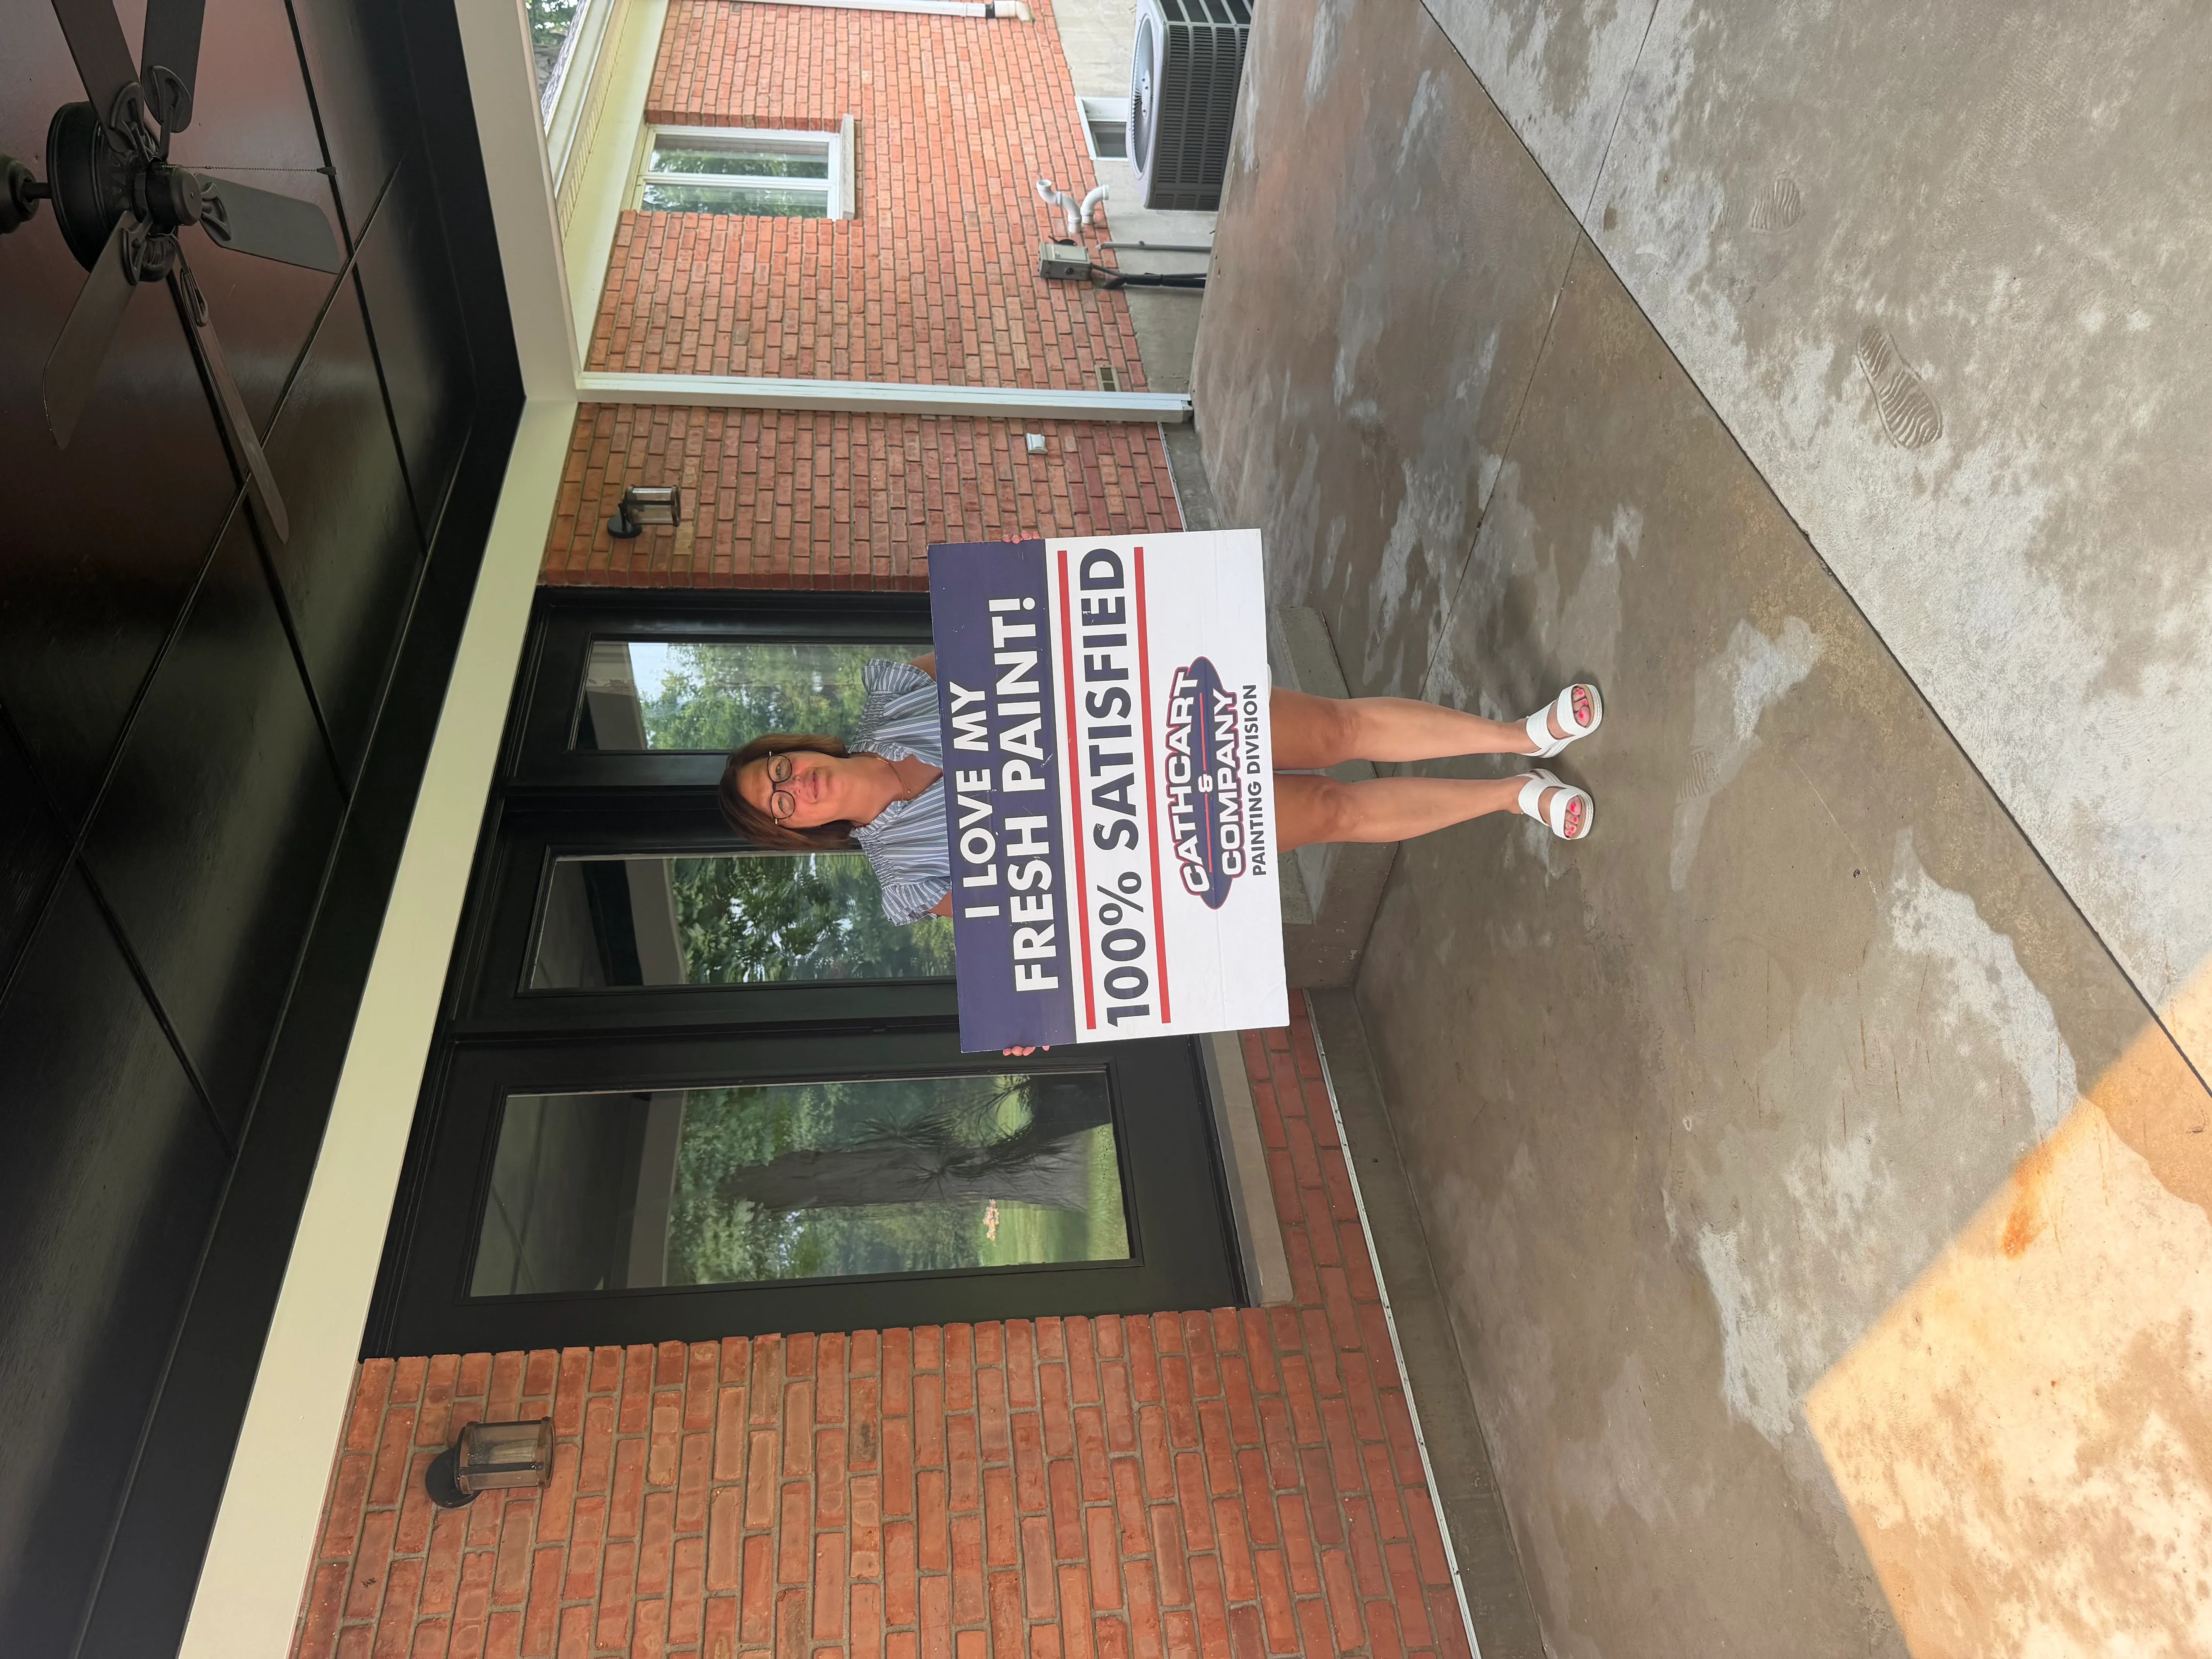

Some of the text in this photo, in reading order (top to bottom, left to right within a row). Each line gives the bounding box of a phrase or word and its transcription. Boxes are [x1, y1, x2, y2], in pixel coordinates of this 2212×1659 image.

[950, 681, 1000, 918] I LOVE MY
[989, 597, 1059, 991] FRESH PAINT!
[1080, 548, 1151, 1027] 100% SATISFIED
[1168, 672, 1209, 892] CATHCART
[1199, 774, 1213, 792] &
[1213, 687, 1243, 876] COMPANY
[1242, 685, 1266, 876] PAINTING DIVISION
